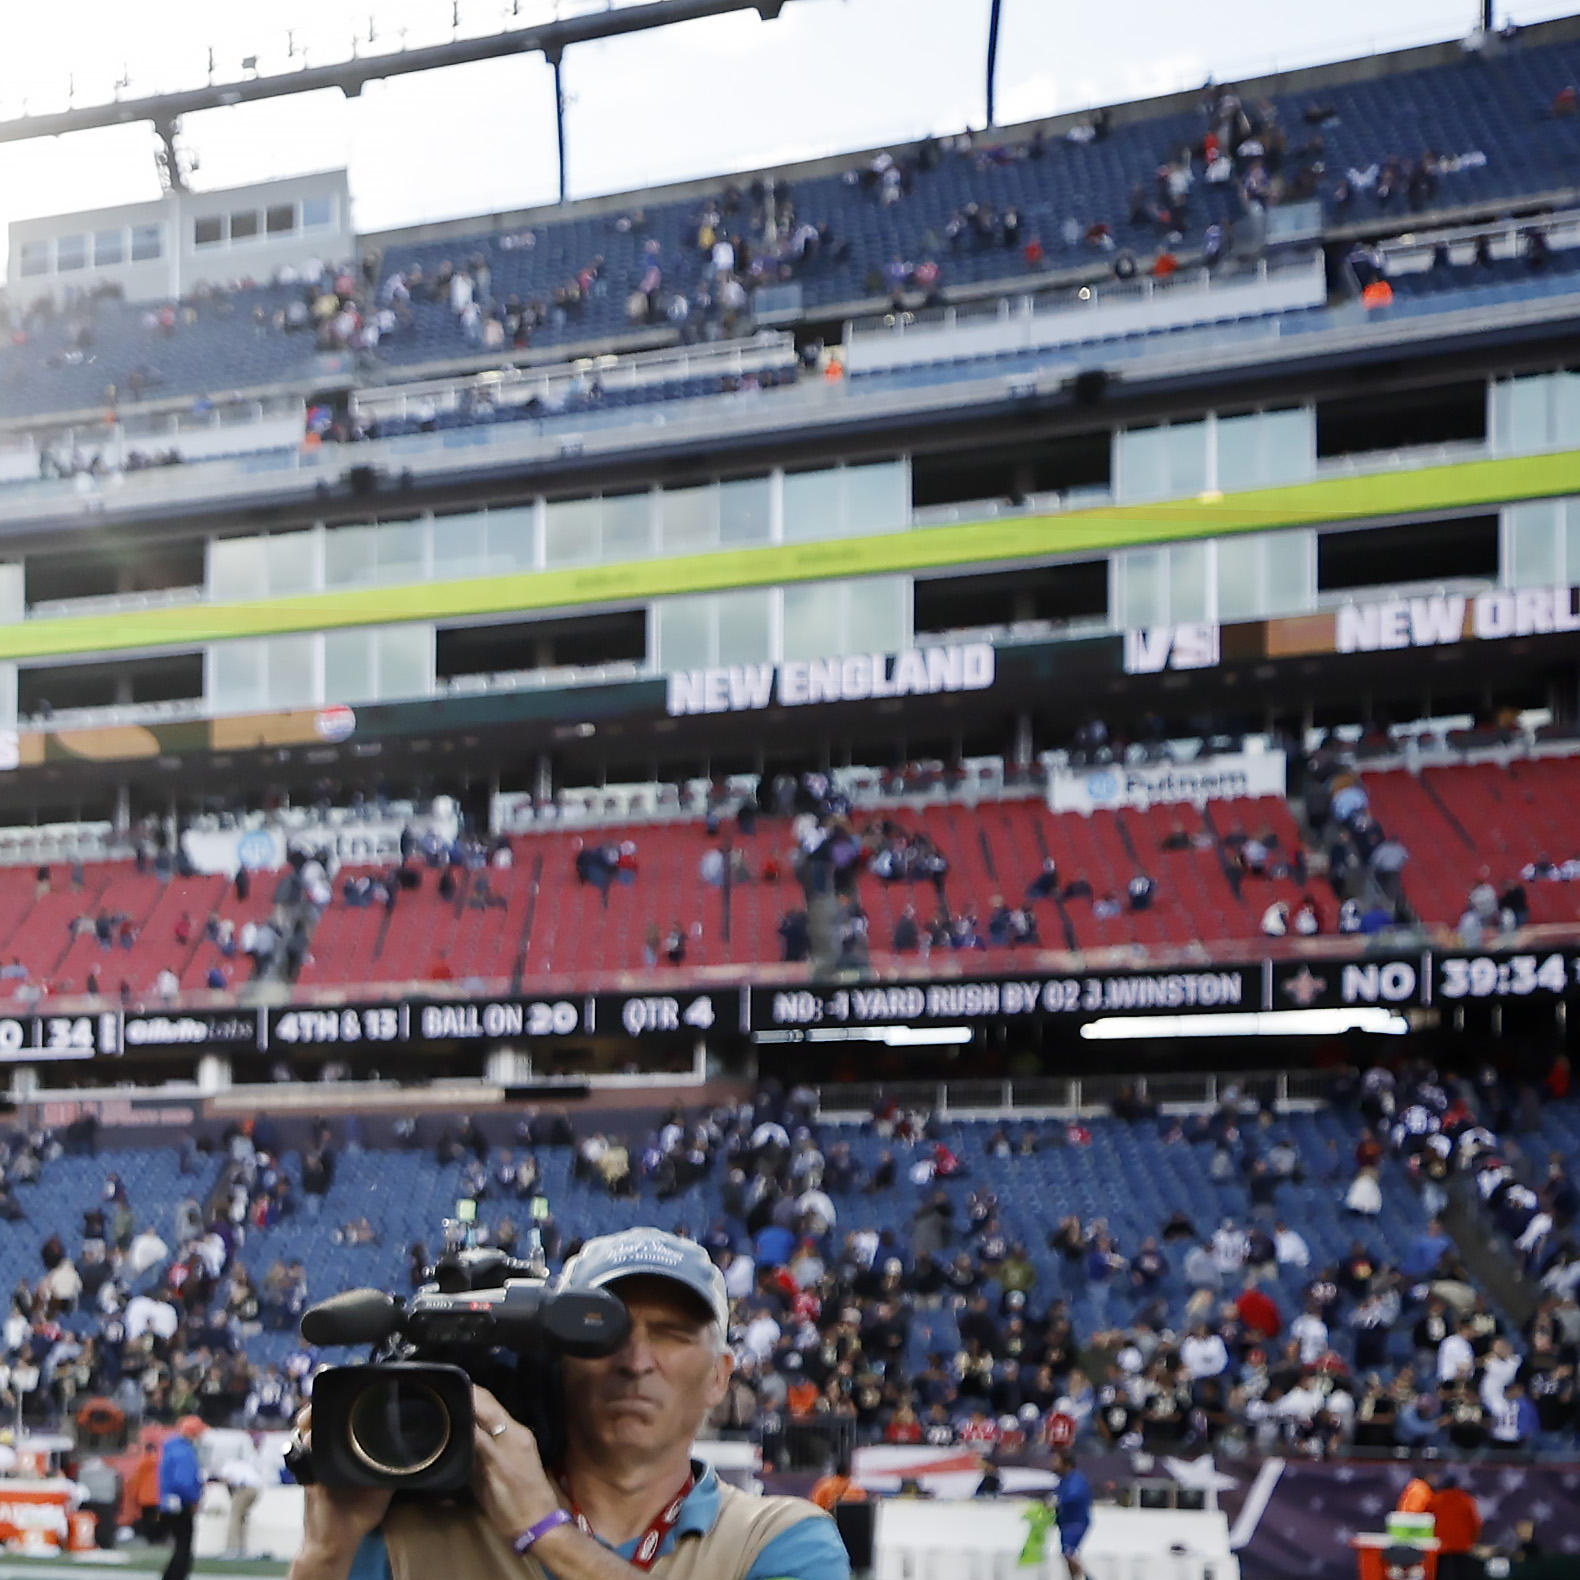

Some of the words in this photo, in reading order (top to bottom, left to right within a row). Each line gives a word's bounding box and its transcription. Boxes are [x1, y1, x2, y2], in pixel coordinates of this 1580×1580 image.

[1123, 622, 1220, 675] VS
[1335, 595, 1465, 653] NEW
[666, 663, 774, 717] NEW
[777, 643, 996, 707] ENGLAND
[852, 986, 925, 1020] YARD
[926, 983, 999, 1017] RUSH
[1000, 981, 1039, 1014] BY
[1042, 979, 1081, 1012] 02
[1342, 961, 1416, 1002] NO
[1441, 953, 1568, 998] 39:34
[47, 1018, 94, 1048] 34
[275, 1010, 339, 1042] 4TH
[340, 1008, 361, 1041] &
[421, 1004, 484, 1039] BALL
[483, 1003, 523, 1037] ON
[524, 1001, 578, 1035] 20
[622, 997, 679, 1037] QTR
[683, 995, 715, 1029] 4
